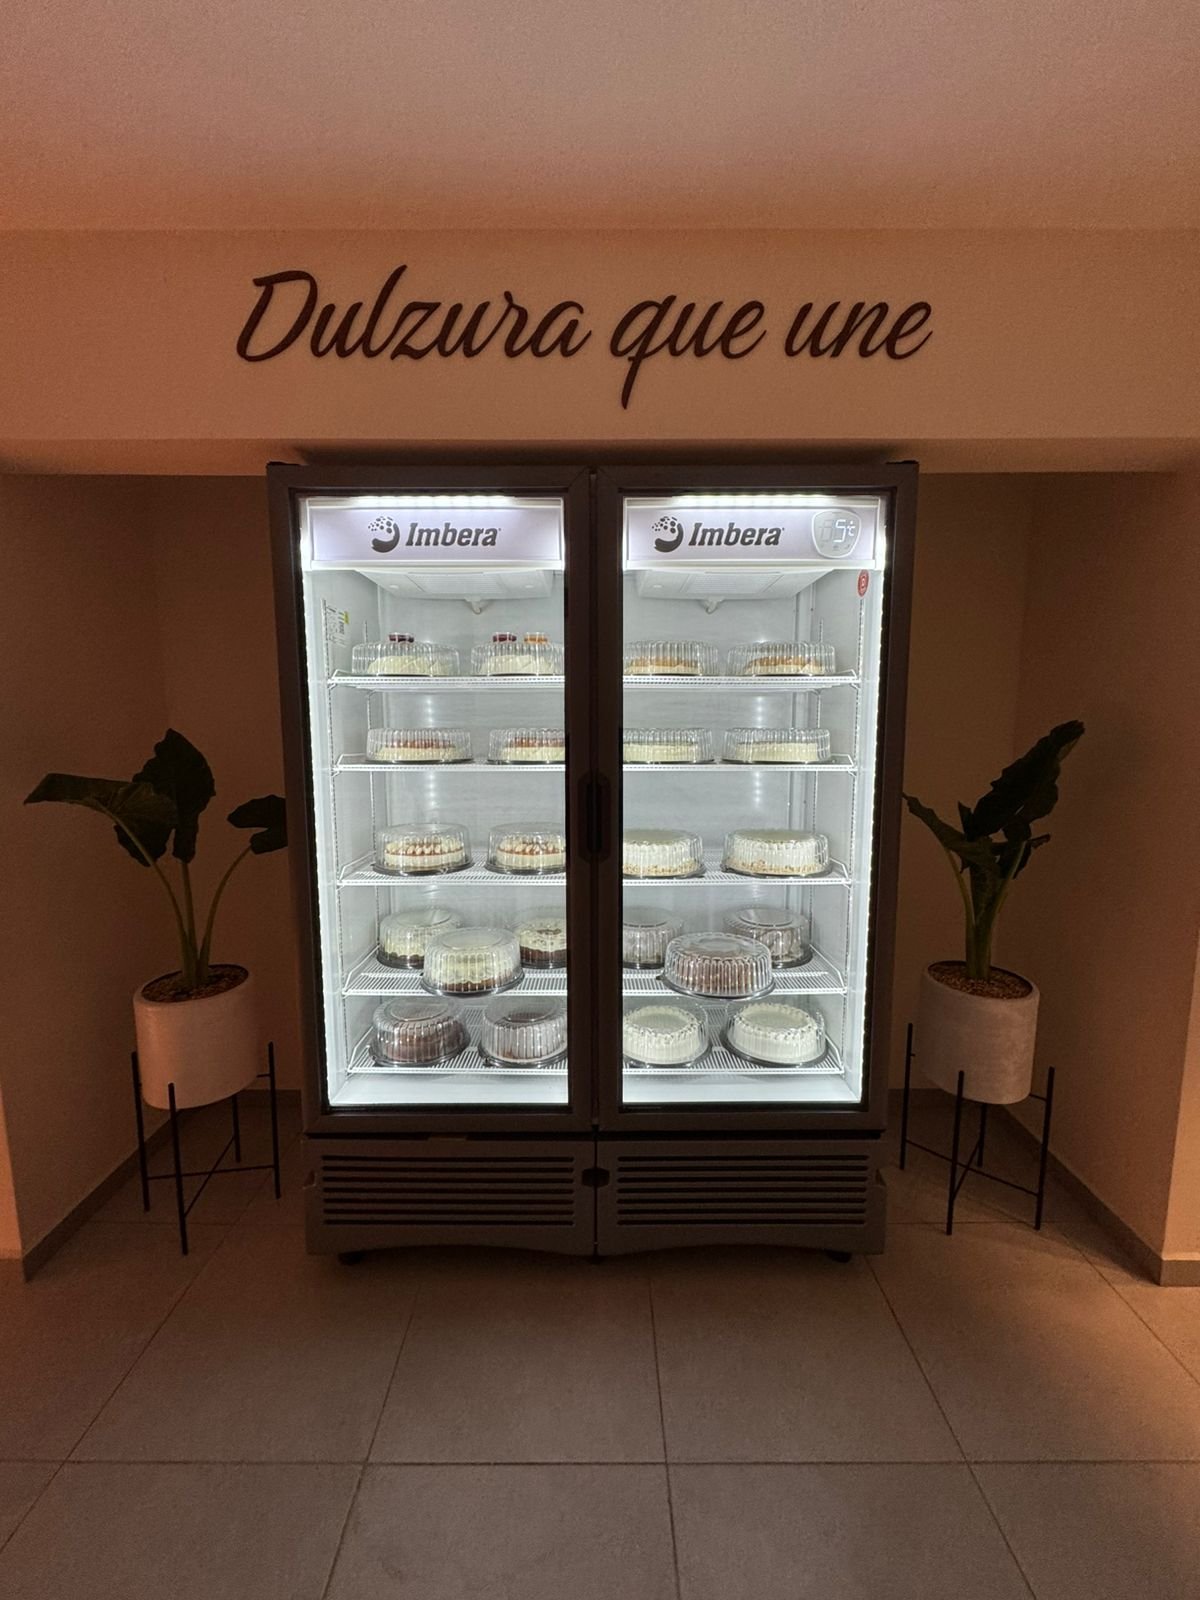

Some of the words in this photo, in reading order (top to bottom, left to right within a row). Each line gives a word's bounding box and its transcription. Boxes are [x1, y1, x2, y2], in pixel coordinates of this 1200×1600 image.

[236, 264, 593, 363] Dulzura
[609, 294, 767, 410] que
[783, 300, 934, 361] une
[405, 522, 499, 547] Imbera
[688, 522, 782, 547] Imbera
